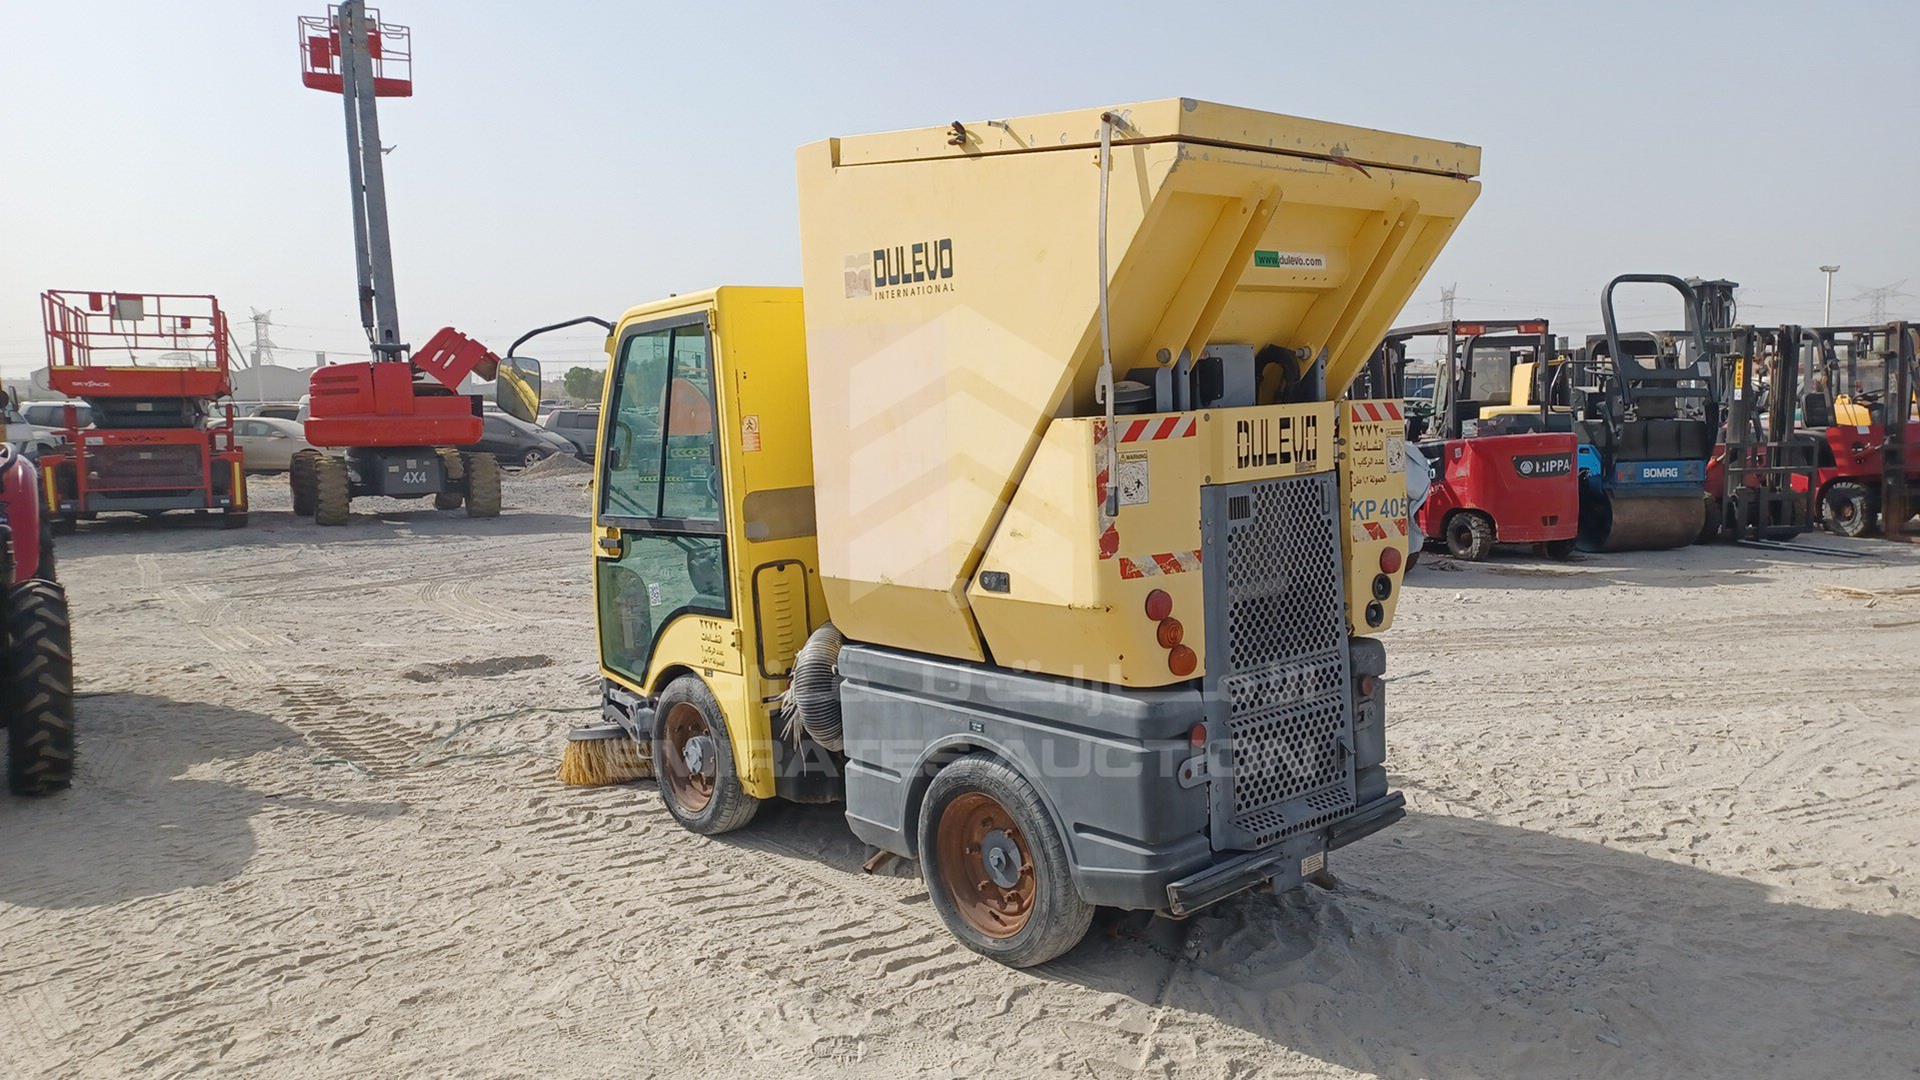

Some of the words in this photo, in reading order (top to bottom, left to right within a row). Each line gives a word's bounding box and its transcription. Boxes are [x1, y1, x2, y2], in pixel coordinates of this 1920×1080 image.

[873, 238, 953, 288] DULEVO
[1257, 254, 1323, 267] www.dulevo.com
[874, 283, 955, 301] INTERNATIONAL
[1352, 424, 1384, 438] ٢٢٧٢٠
[1237, 414, 1317, 469] DULEVO
[403, 471, 427, 484] 4X4
[1643, 467, 1679, 478] BOMAG
[1352, 500, 1377, 521] KP
[1379, 498, 1408, 518] 405
